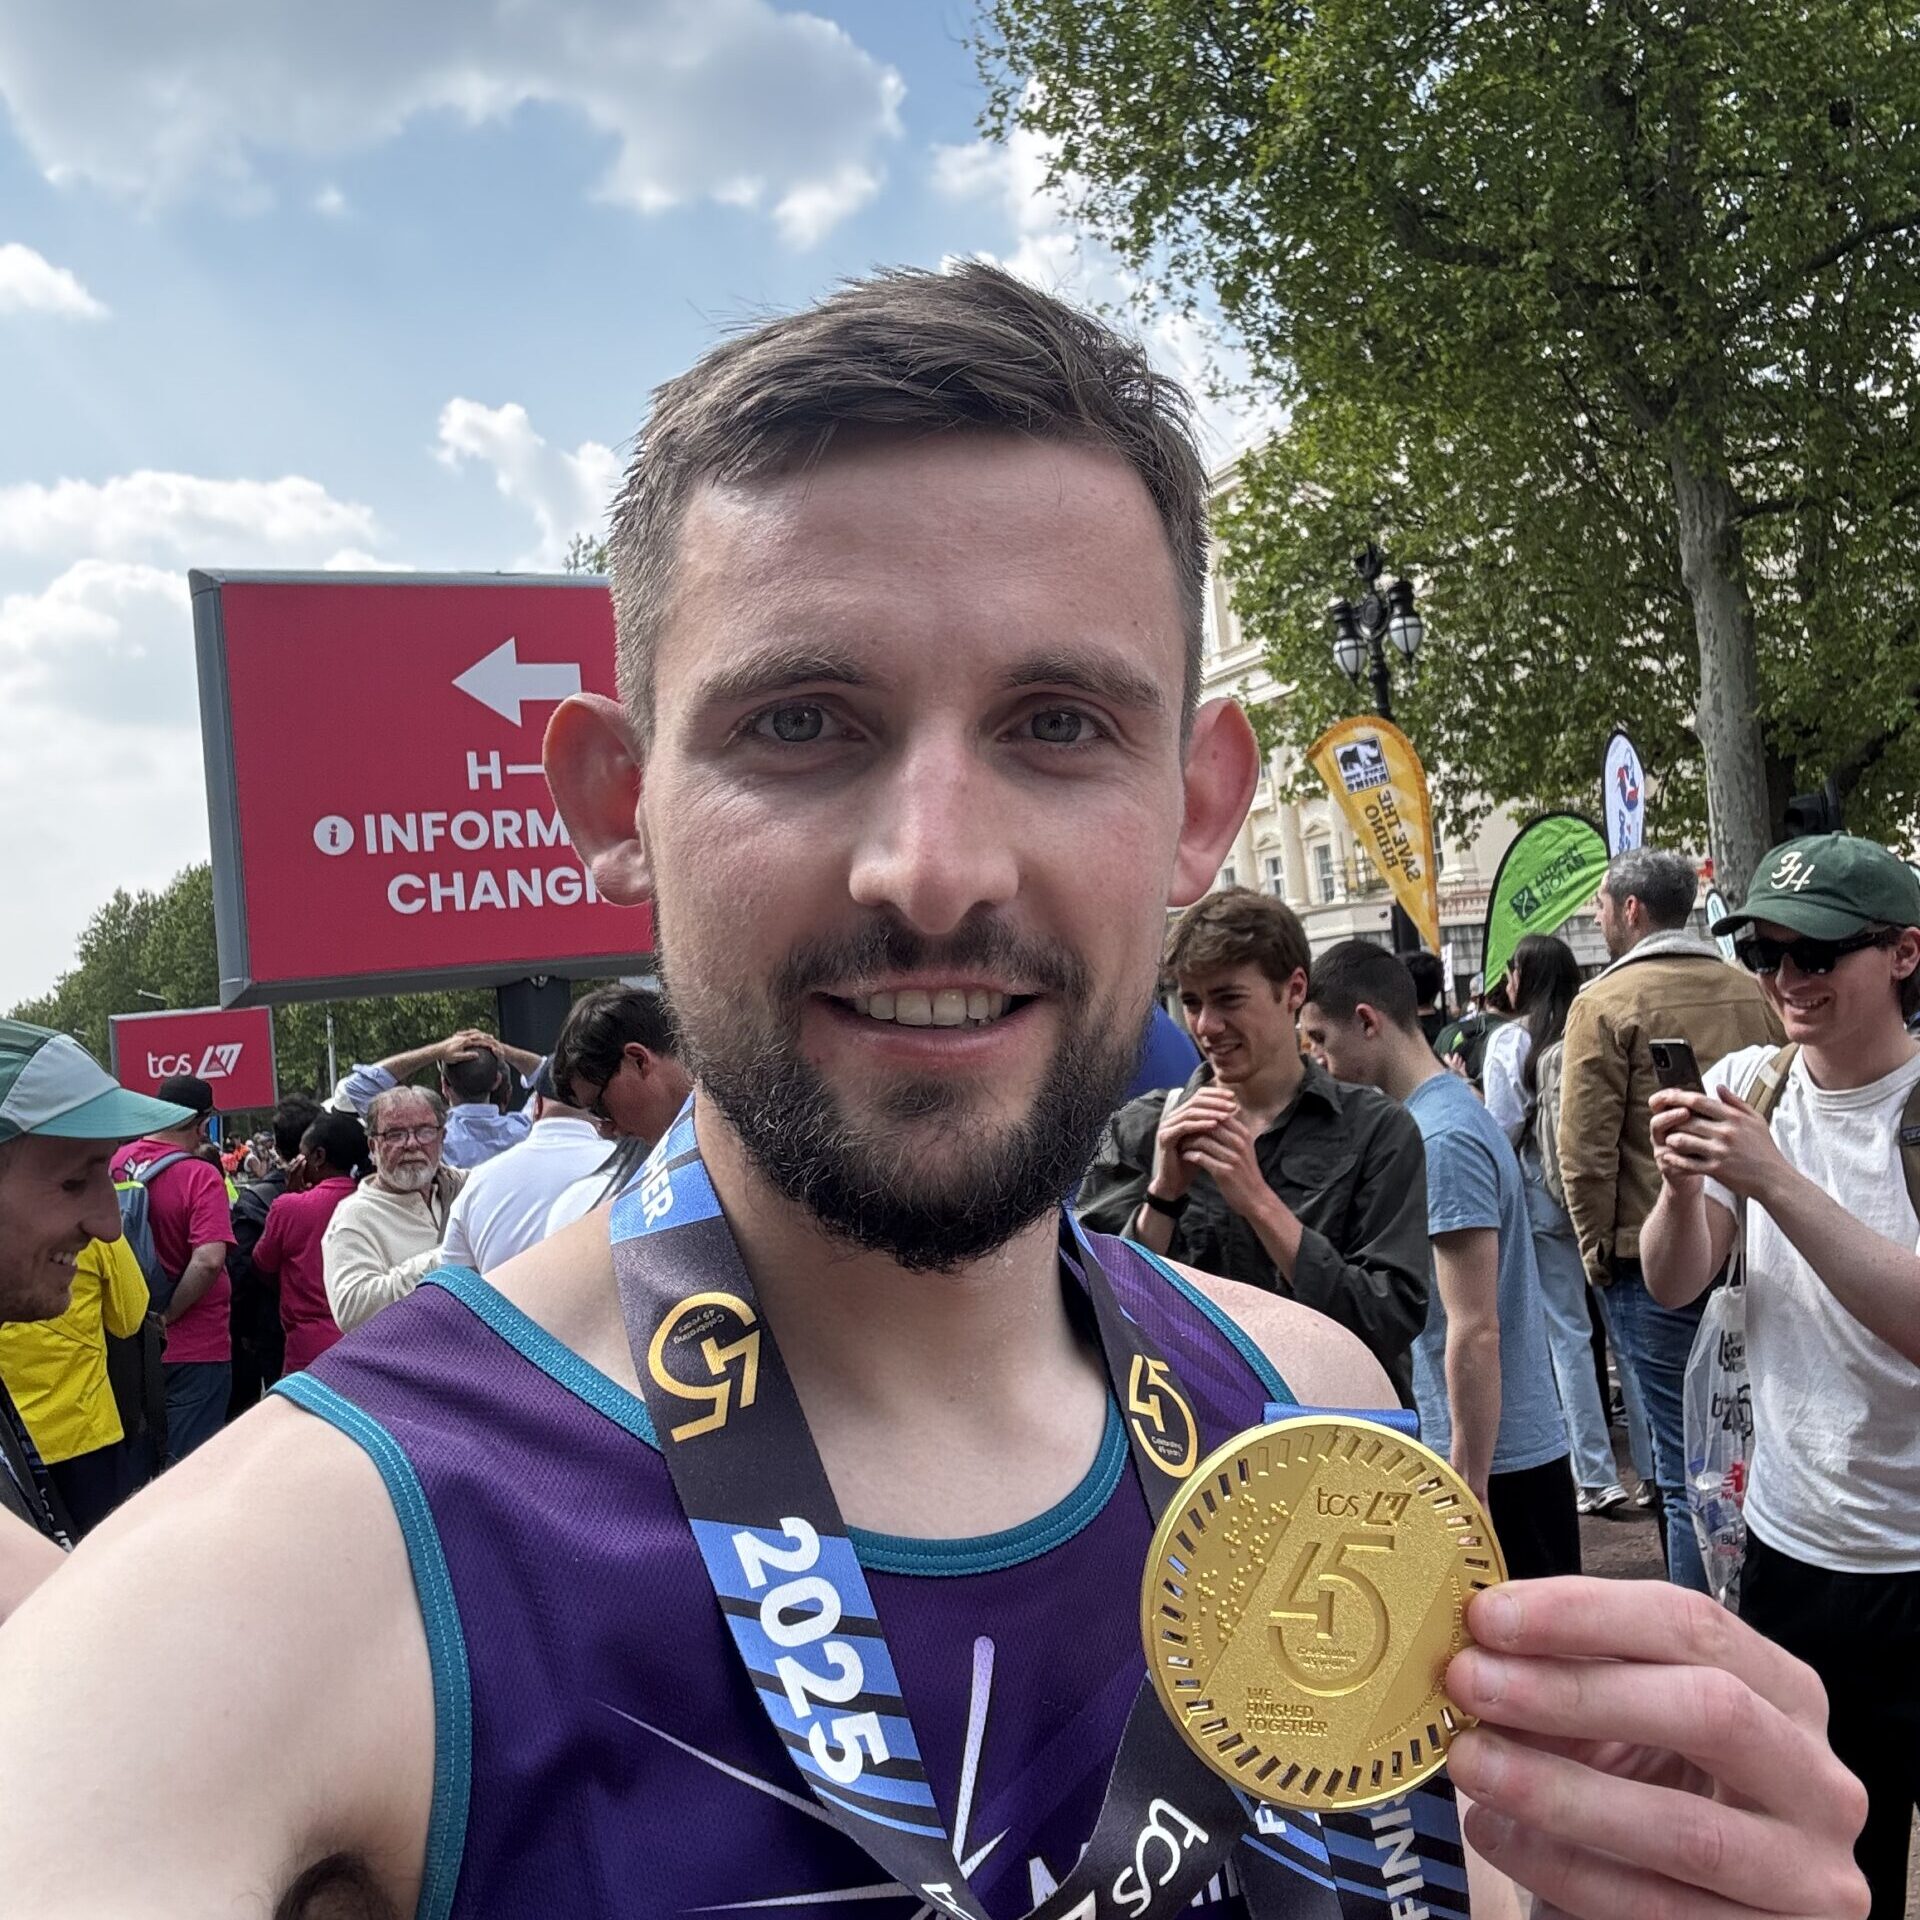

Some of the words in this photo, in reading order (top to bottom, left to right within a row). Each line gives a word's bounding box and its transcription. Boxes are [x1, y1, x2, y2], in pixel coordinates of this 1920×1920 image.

[363, 808, 571, 855] INFORM
[147, 1051, 192, 1079] tcs
[1317, 1487, 1360, 1518] tcs
[731, 1516, 891, 1784] 2025
[1246, 1687, 1274, 1704] WE
[1245, 1702, 1315, 1722] FINISHED
[1245, 1719, 1329, 1738] TOGETHER
[1255, 1800, 1288, 1835] F
[1112, 1798, 1210, 1918] tcs
